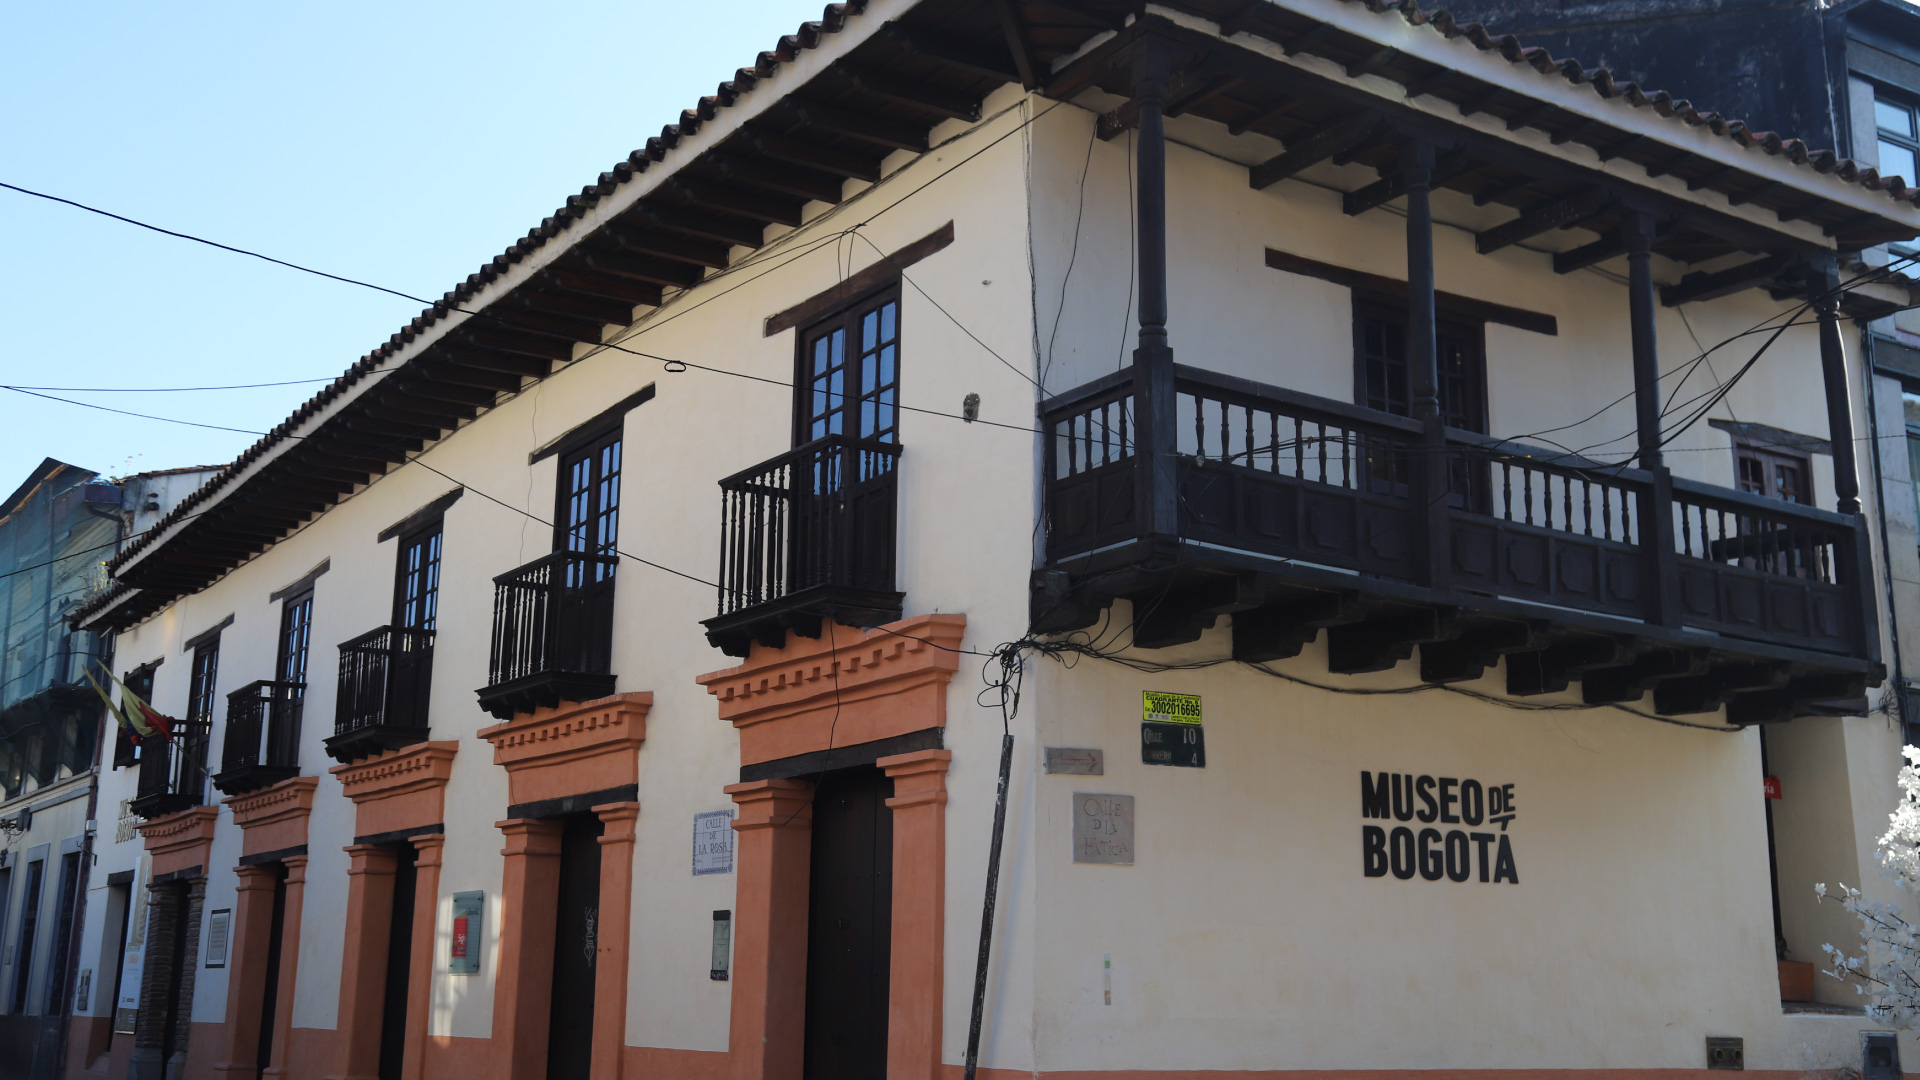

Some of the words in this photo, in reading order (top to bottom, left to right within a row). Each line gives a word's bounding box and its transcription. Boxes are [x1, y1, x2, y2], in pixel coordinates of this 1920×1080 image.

[1145, 695, 1183, 704] CUADRANTE
[1151, 701, 1200, 717] 3002016695
[1183, 728, 1196, 744] 10
[1191, 752, 1198, 766] 4
[1361, 771, 1484, 826] MUSEO
[1489, 783, 1516, 816] DE
[1083, 797, 1121, 817] CALLE
[705, 817, 722, 829] CALLE
[698, 844, 707, 854] LA
[710, 842, 729, 854] ROSA
[1363, 814, 1519, 884] BOGOTÁ
